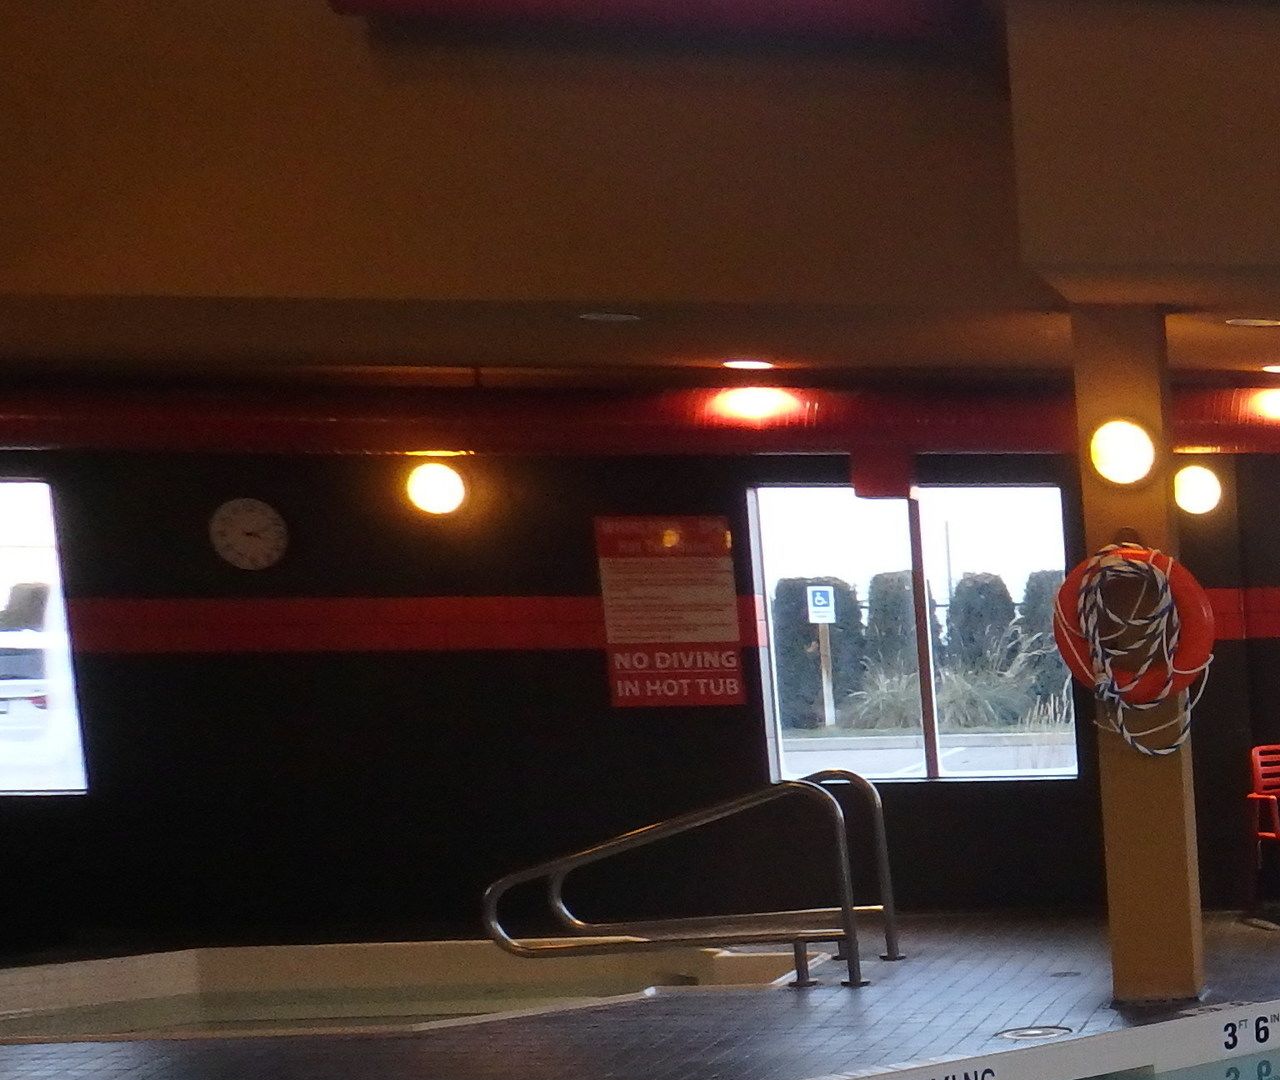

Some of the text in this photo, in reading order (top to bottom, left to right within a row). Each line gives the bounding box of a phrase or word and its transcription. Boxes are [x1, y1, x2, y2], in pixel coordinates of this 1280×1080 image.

[614, 651, 737, 669] NO DIVING
[616, 678, 739, 697] IN HOT TUB
